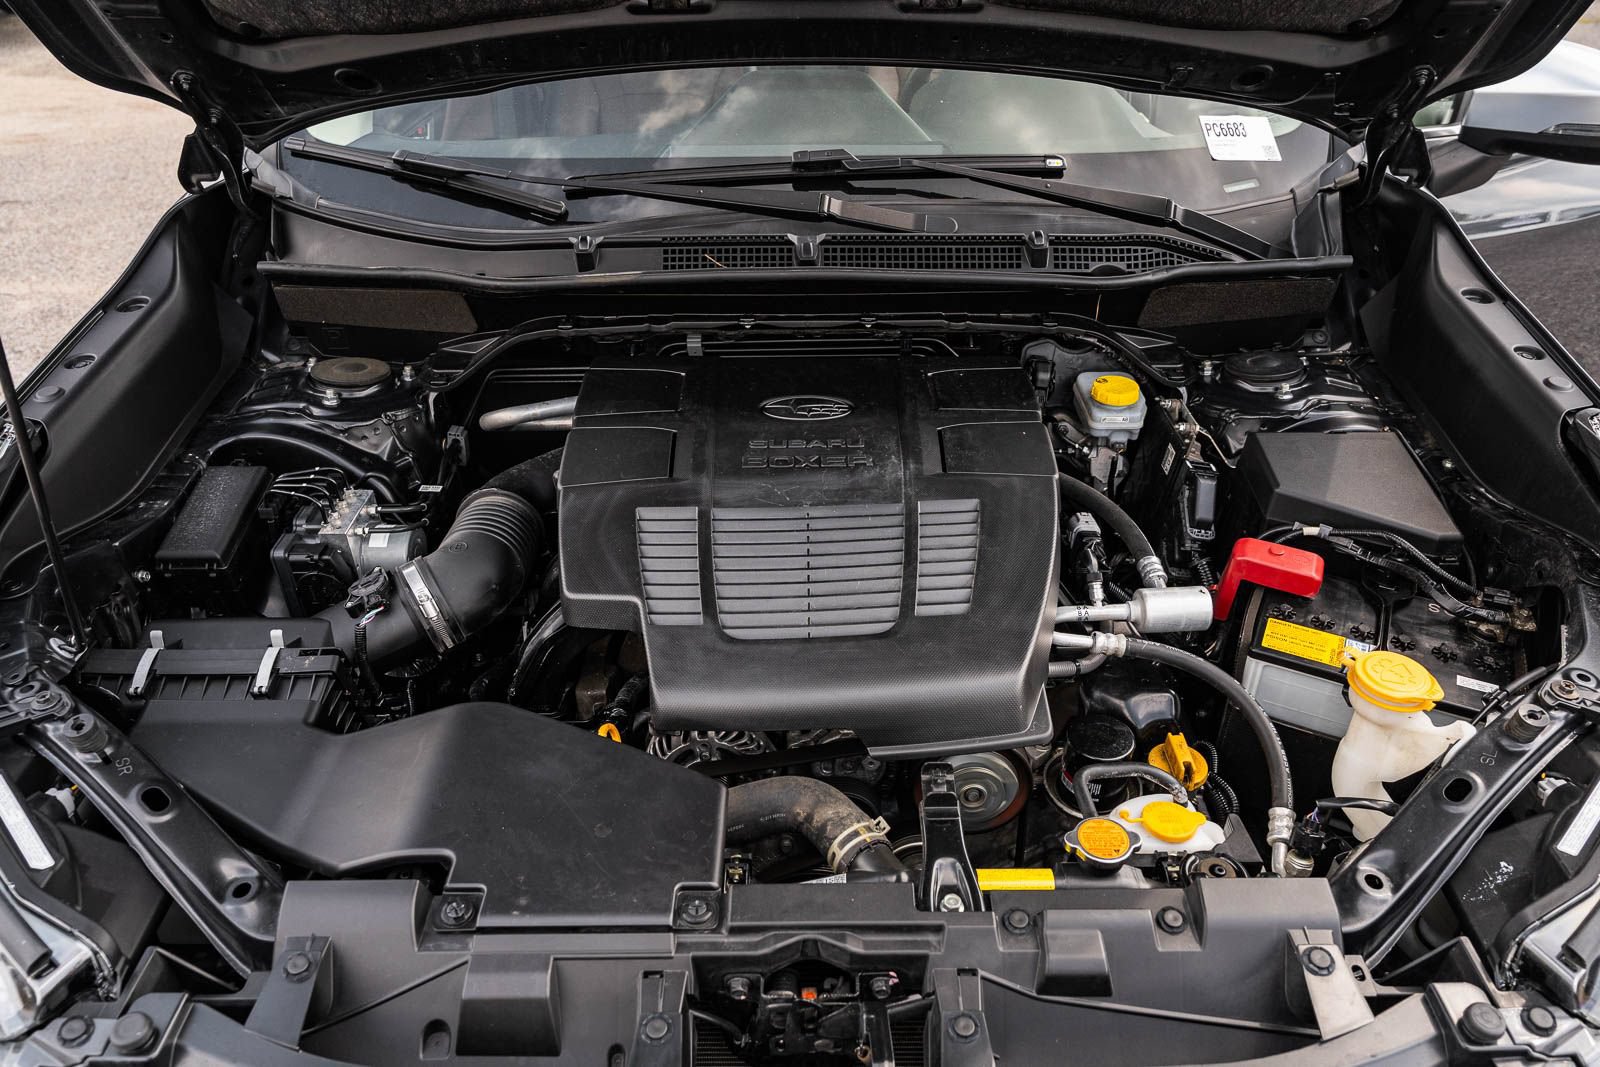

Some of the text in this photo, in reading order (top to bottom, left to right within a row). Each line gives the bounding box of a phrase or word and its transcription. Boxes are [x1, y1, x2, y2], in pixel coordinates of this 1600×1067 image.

[1204, 122, 1247, 138] PC6683
[749, 438, 865, 449] SUBARU
[741, 455, 874, 469] BOXER
[1480, 751, 1498, 766] SL
[115, 757, 134, 776] SR
